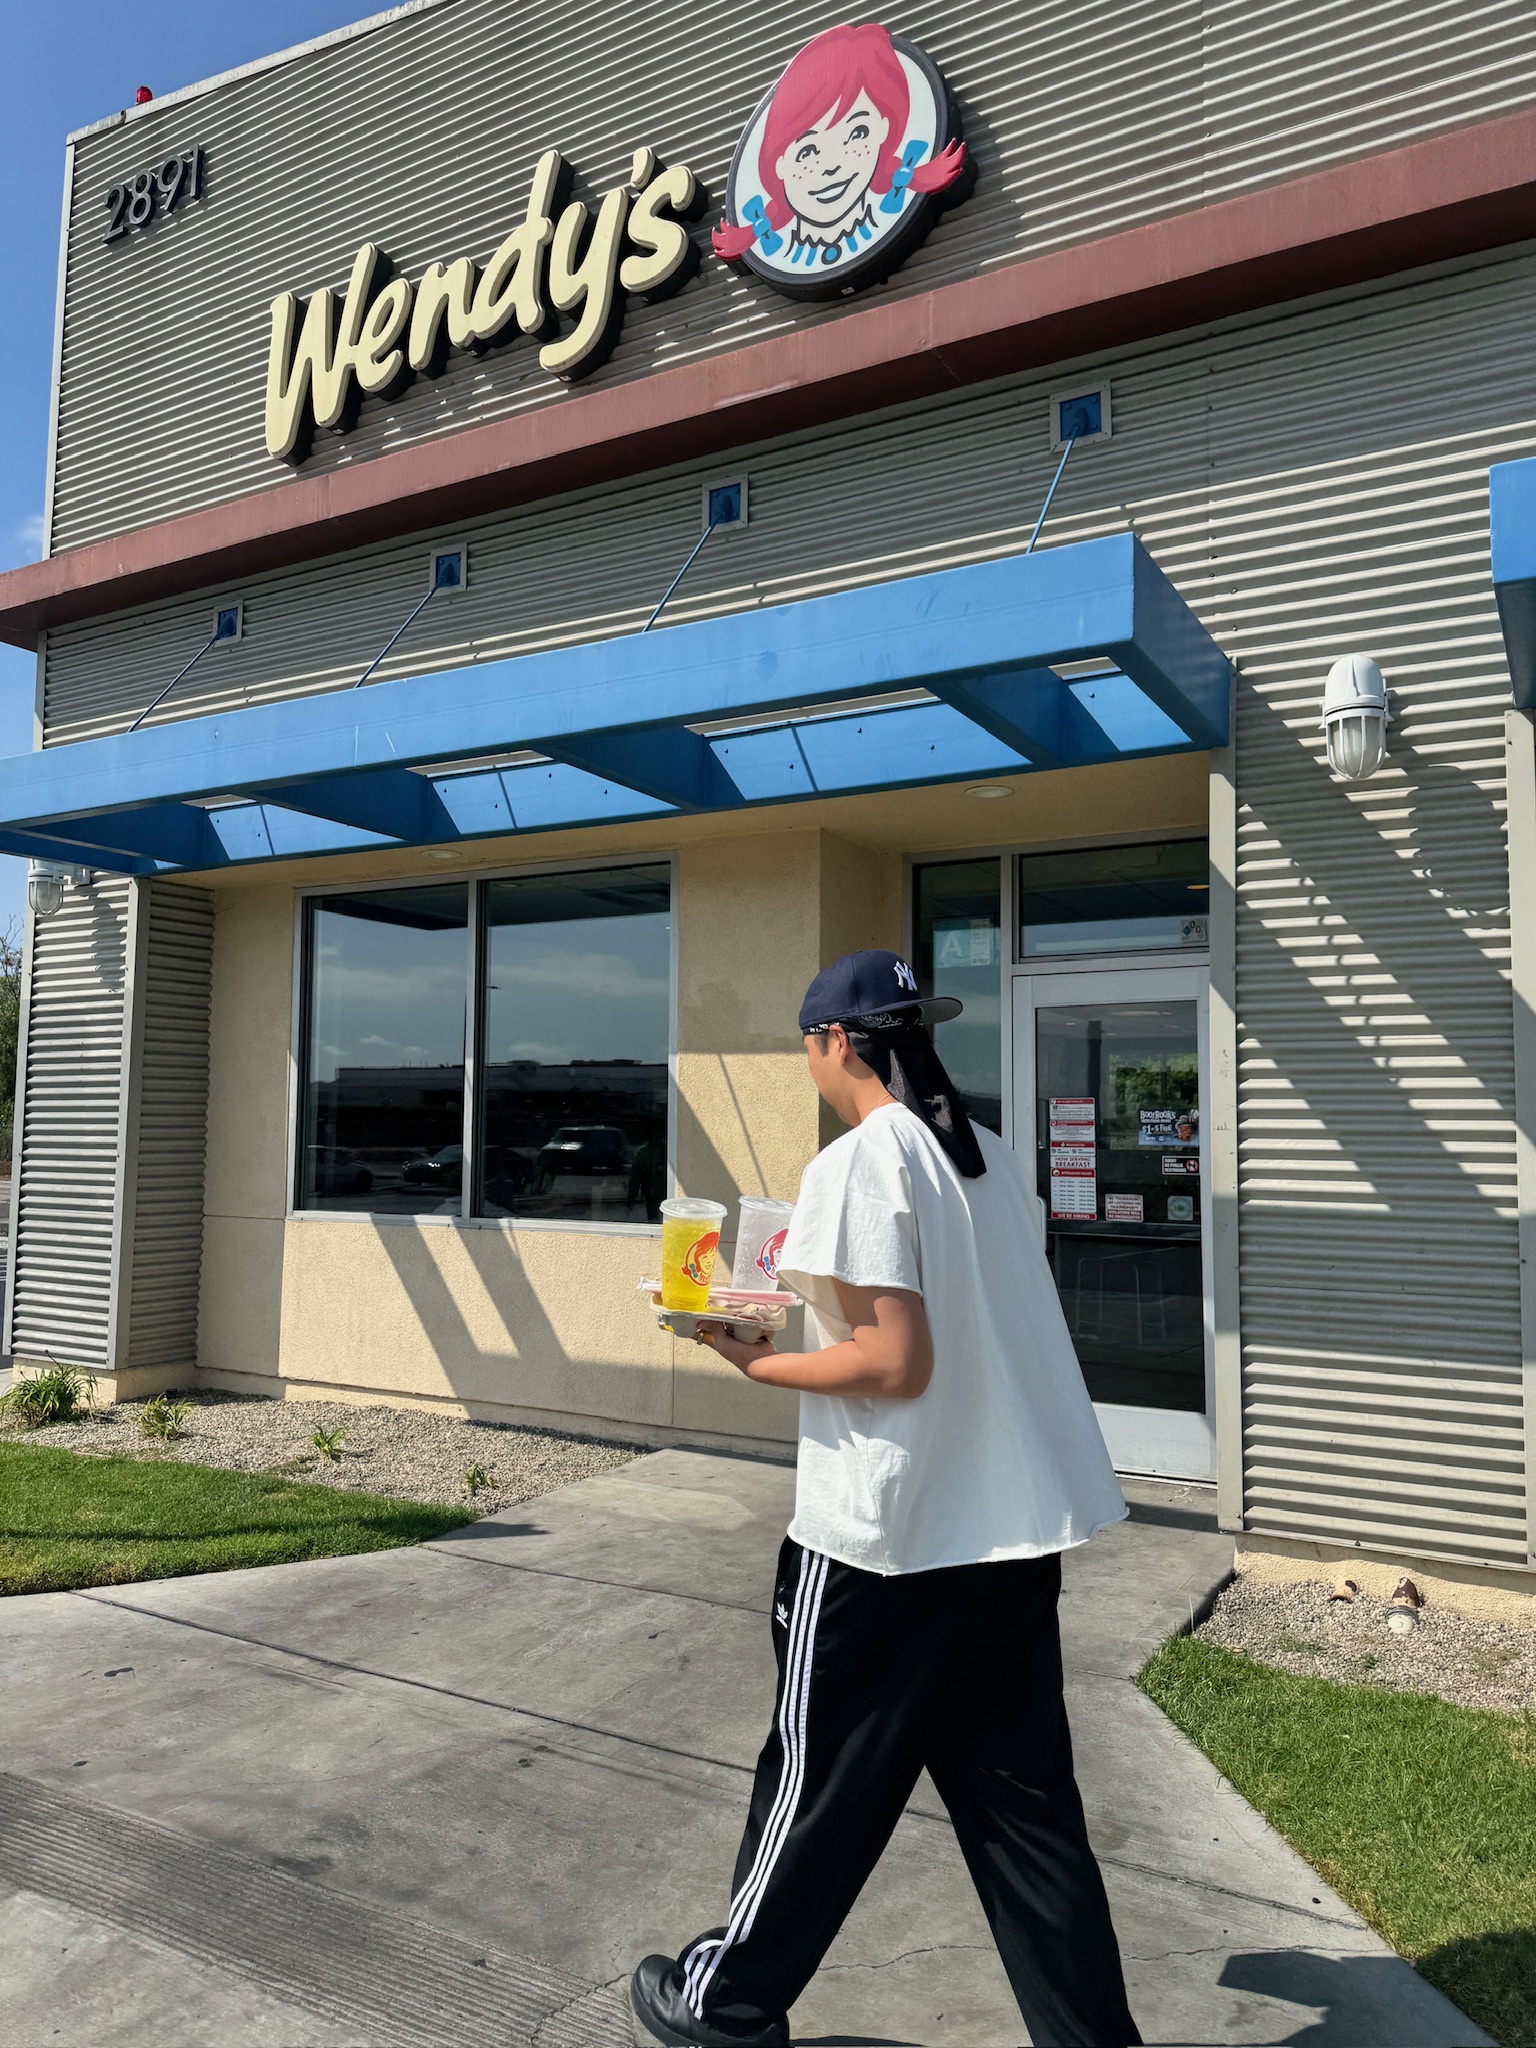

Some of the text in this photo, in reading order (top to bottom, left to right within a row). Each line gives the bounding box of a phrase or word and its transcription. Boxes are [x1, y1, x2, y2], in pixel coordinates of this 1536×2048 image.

[102, 143, 205, 243] 2891
[265, 146, 705, 463] Wendy's
[1190, 920, 1196, 929] 0
[1195, 925, 1202, 933] 0
[938, 930, 966, 959] A
[892, 960, 918, 991] NY
[1141, 1124, 1152, 1135] $1
